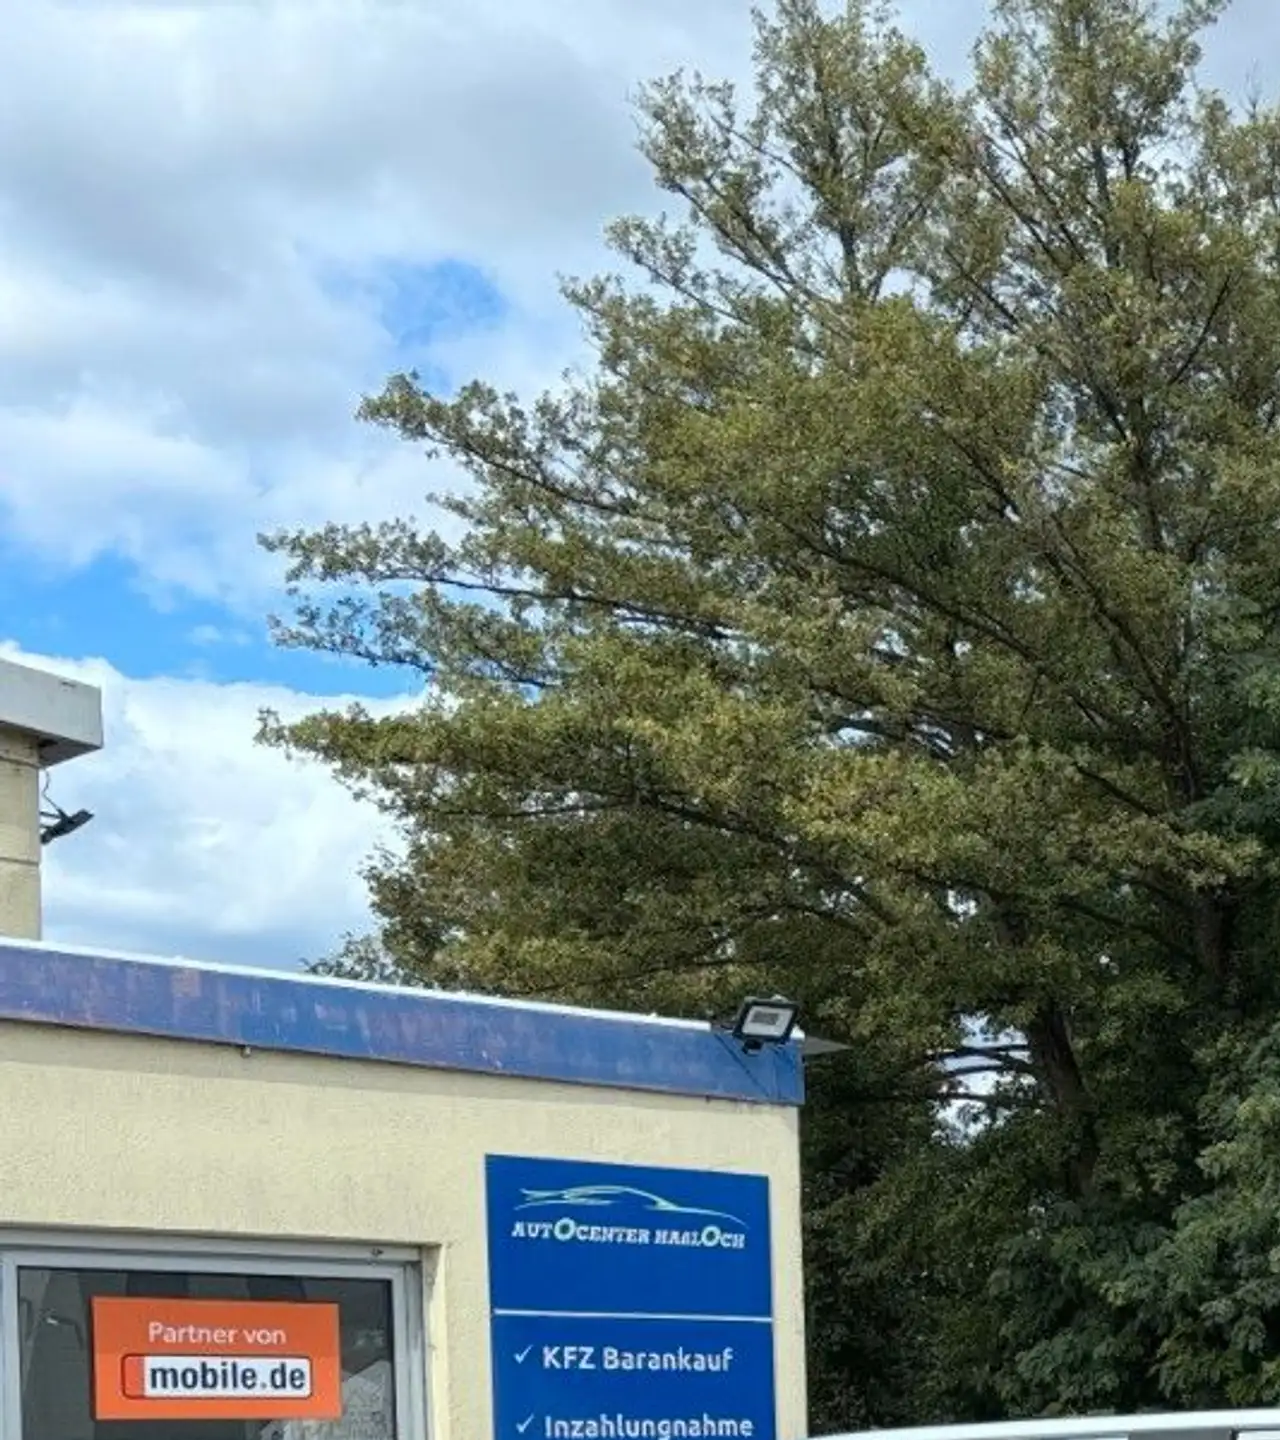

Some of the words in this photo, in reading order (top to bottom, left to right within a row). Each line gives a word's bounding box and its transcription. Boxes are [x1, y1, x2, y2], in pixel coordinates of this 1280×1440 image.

[511, 1217, 650, 1244] AUTOCENTER
[148, 1322, 240, 1344] Partner
[244, 1327, 287, 1345] von
[543, 1346, 596, 1369] KFZ
[603, 1347, 733, 1371] Barankauf
[150, 1361, 306, 1390] mobile.de
